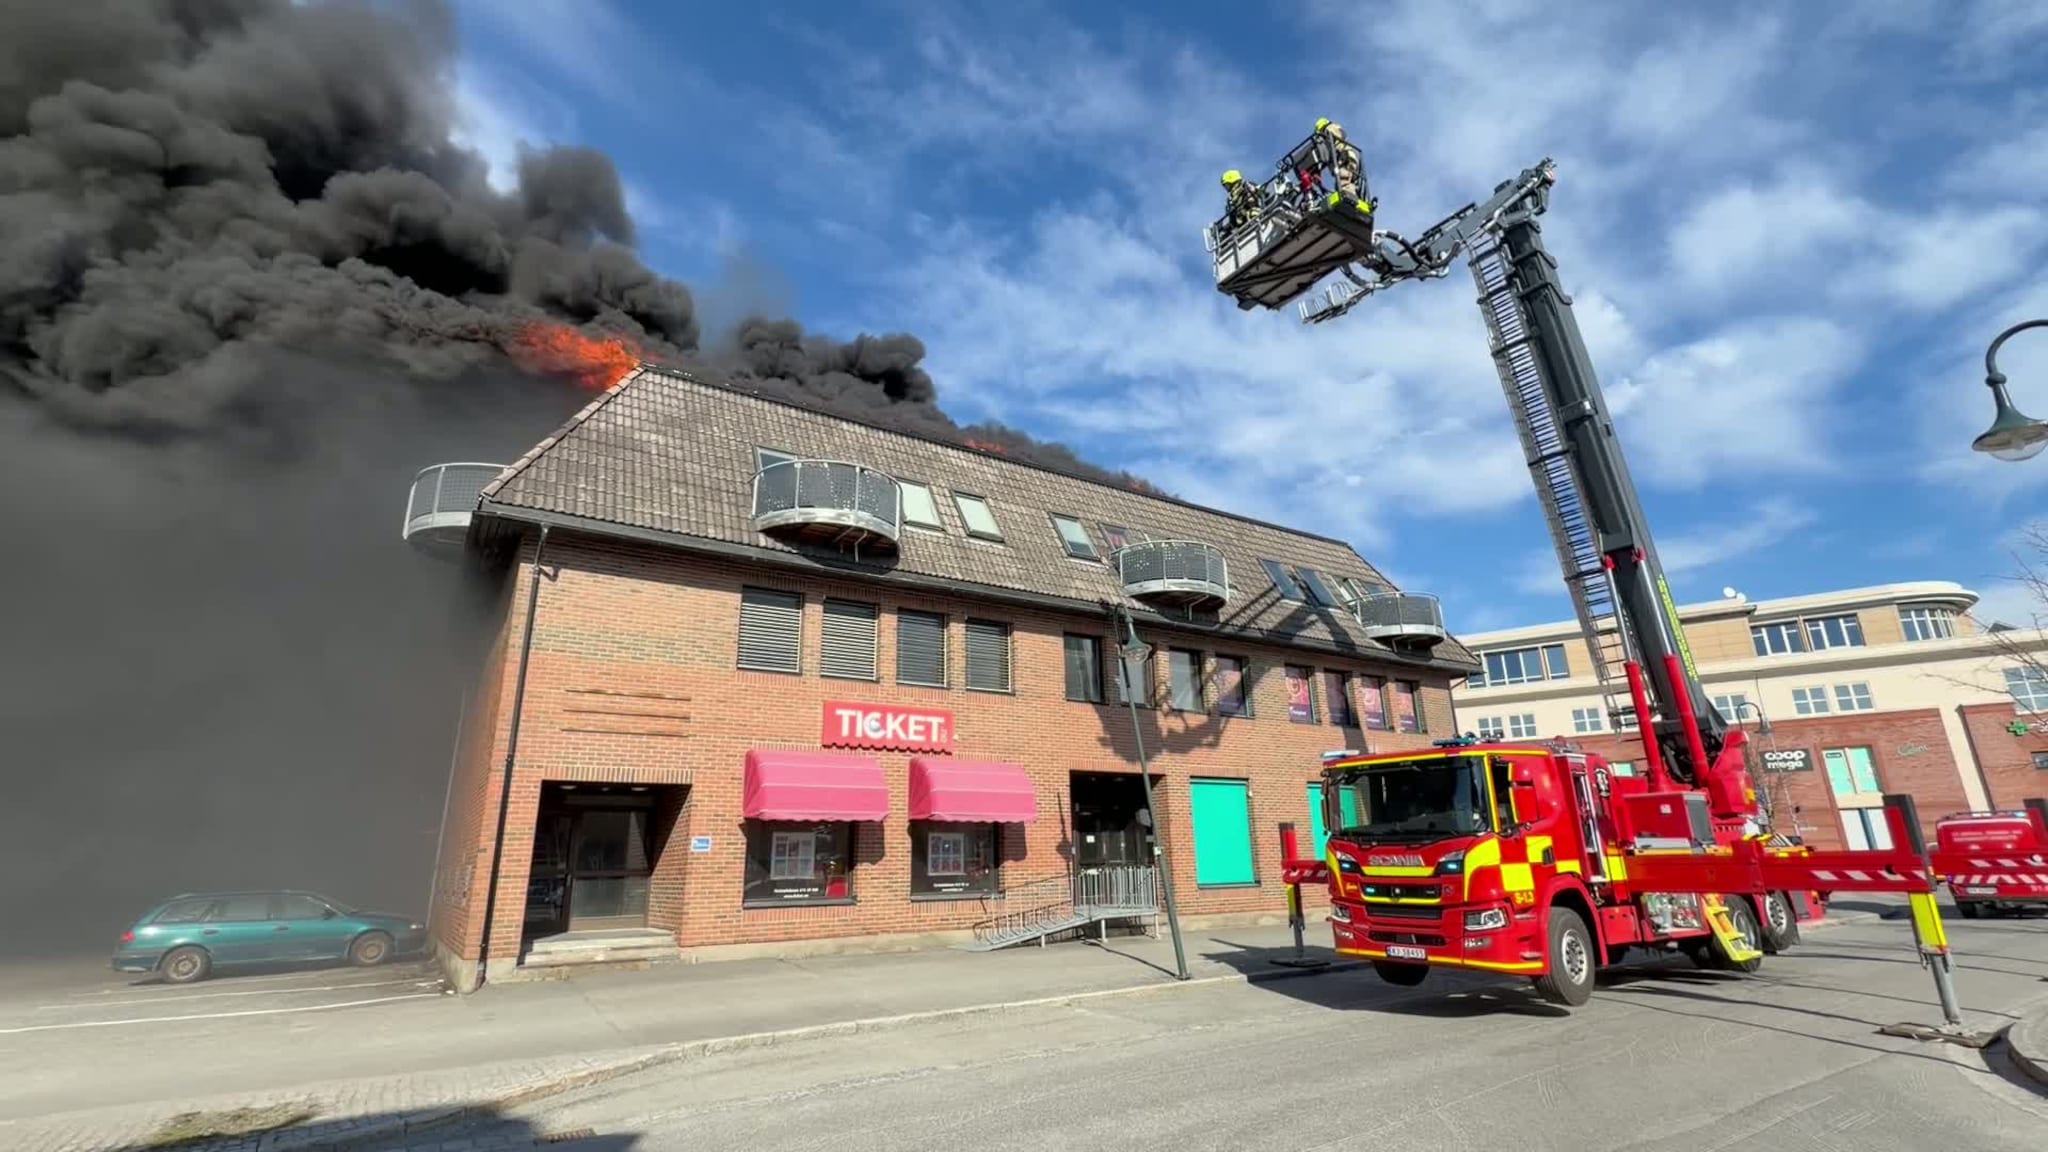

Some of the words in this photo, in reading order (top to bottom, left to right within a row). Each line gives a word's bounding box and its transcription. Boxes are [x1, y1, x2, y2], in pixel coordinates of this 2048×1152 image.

[835, 708, 945, 743] TICKET
[1764, 750, 1806, 760] coop
[1767, 760, 1803, 770] mega
[1368, 854, 1425, 867] SCANIA
